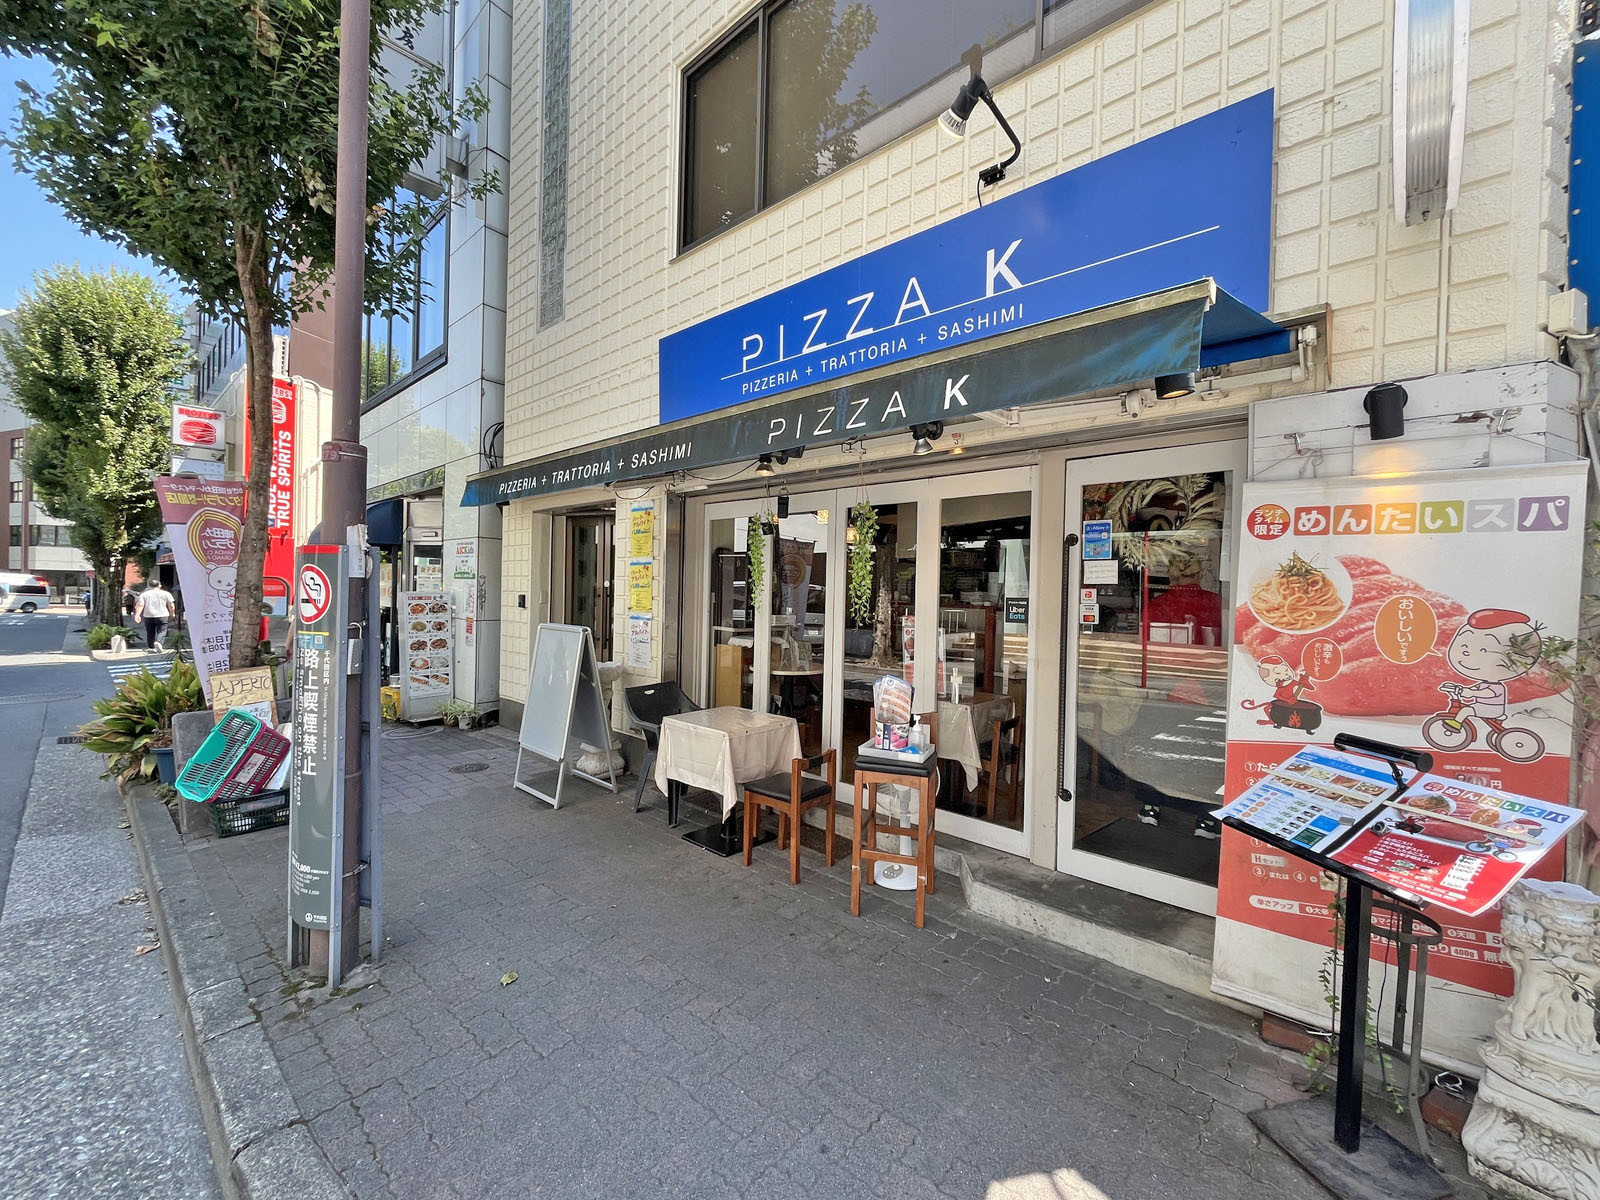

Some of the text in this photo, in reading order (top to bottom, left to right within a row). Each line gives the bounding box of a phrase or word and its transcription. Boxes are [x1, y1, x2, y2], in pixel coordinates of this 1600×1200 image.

[742, 238, 1024, 374] PIZZA K
[742, 368, 798, 395] PIZZERIA
[820, 338, 907, 374] TRATTORIA
[937, 303, 1024, 341] SASHIMI
[767, 374, 970, 445] PIZZA K
[277, 430, 292, 529] TRUE SPIRITS
[498, 476, 537, 496] PIZZERIA
[551, 460, 611, 485] TRATTORIA
[630, 442, 693, 470] SASHIMI
[1254, 508, 1283, 517] ランチ
[1254, 516, 1283, 524] タイム
[1254, 524, 1283, 536] 限定
[1297, 498, 1566, 533] めんたいスパ
[215, 675, 272, 698] APERTO
[302, 648, 319, 776] 路上喫煙禁止
